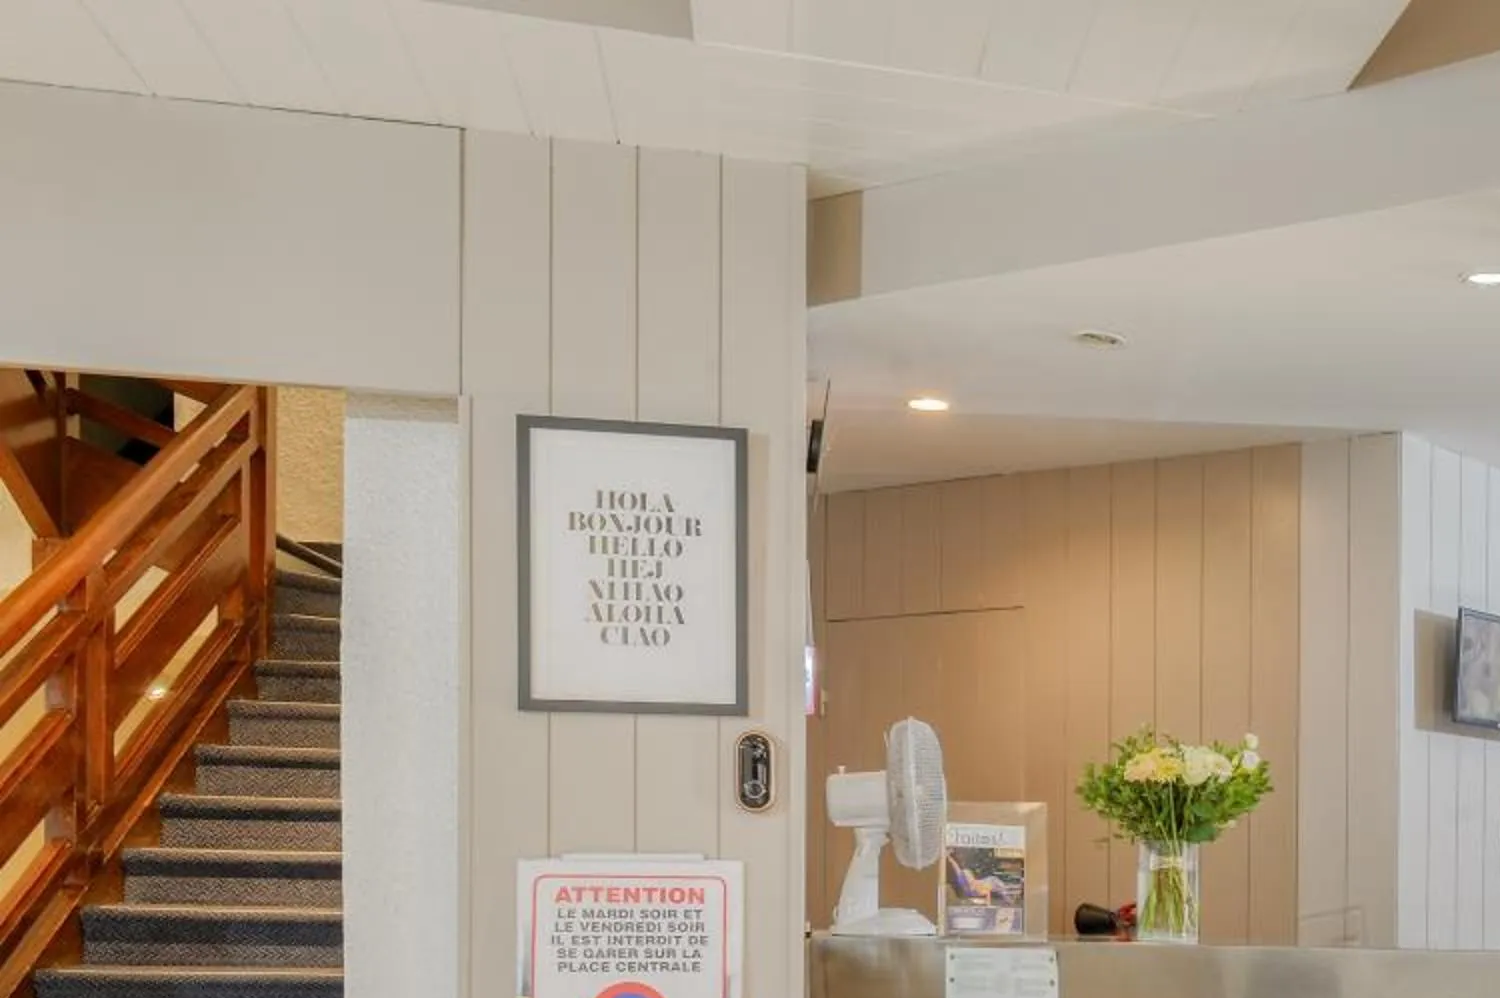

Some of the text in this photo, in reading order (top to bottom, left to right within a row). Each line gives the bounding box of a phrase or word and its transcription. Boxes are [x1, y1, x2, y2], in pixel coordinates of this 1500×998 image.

[596, 490, 674, 512] HOLA
[568, 511, 702, 537] BONJOUR
[588, 535, 683, 558] HELLO
[600, 626, 671, 646] CIAO
[555, 887, 705, 904] ATTENTION
[557, 909, 704, 920] LE MARDI SOIR ET
[554, 922, 705, 933] LE VENDREDI SOIR
[551, 936, 708, 946] IL EST INTERDIT DE
[557, 948, 702, 959] SE GARER SUR LA
[558, 962, 701, 972] PLACE CENTRALE
